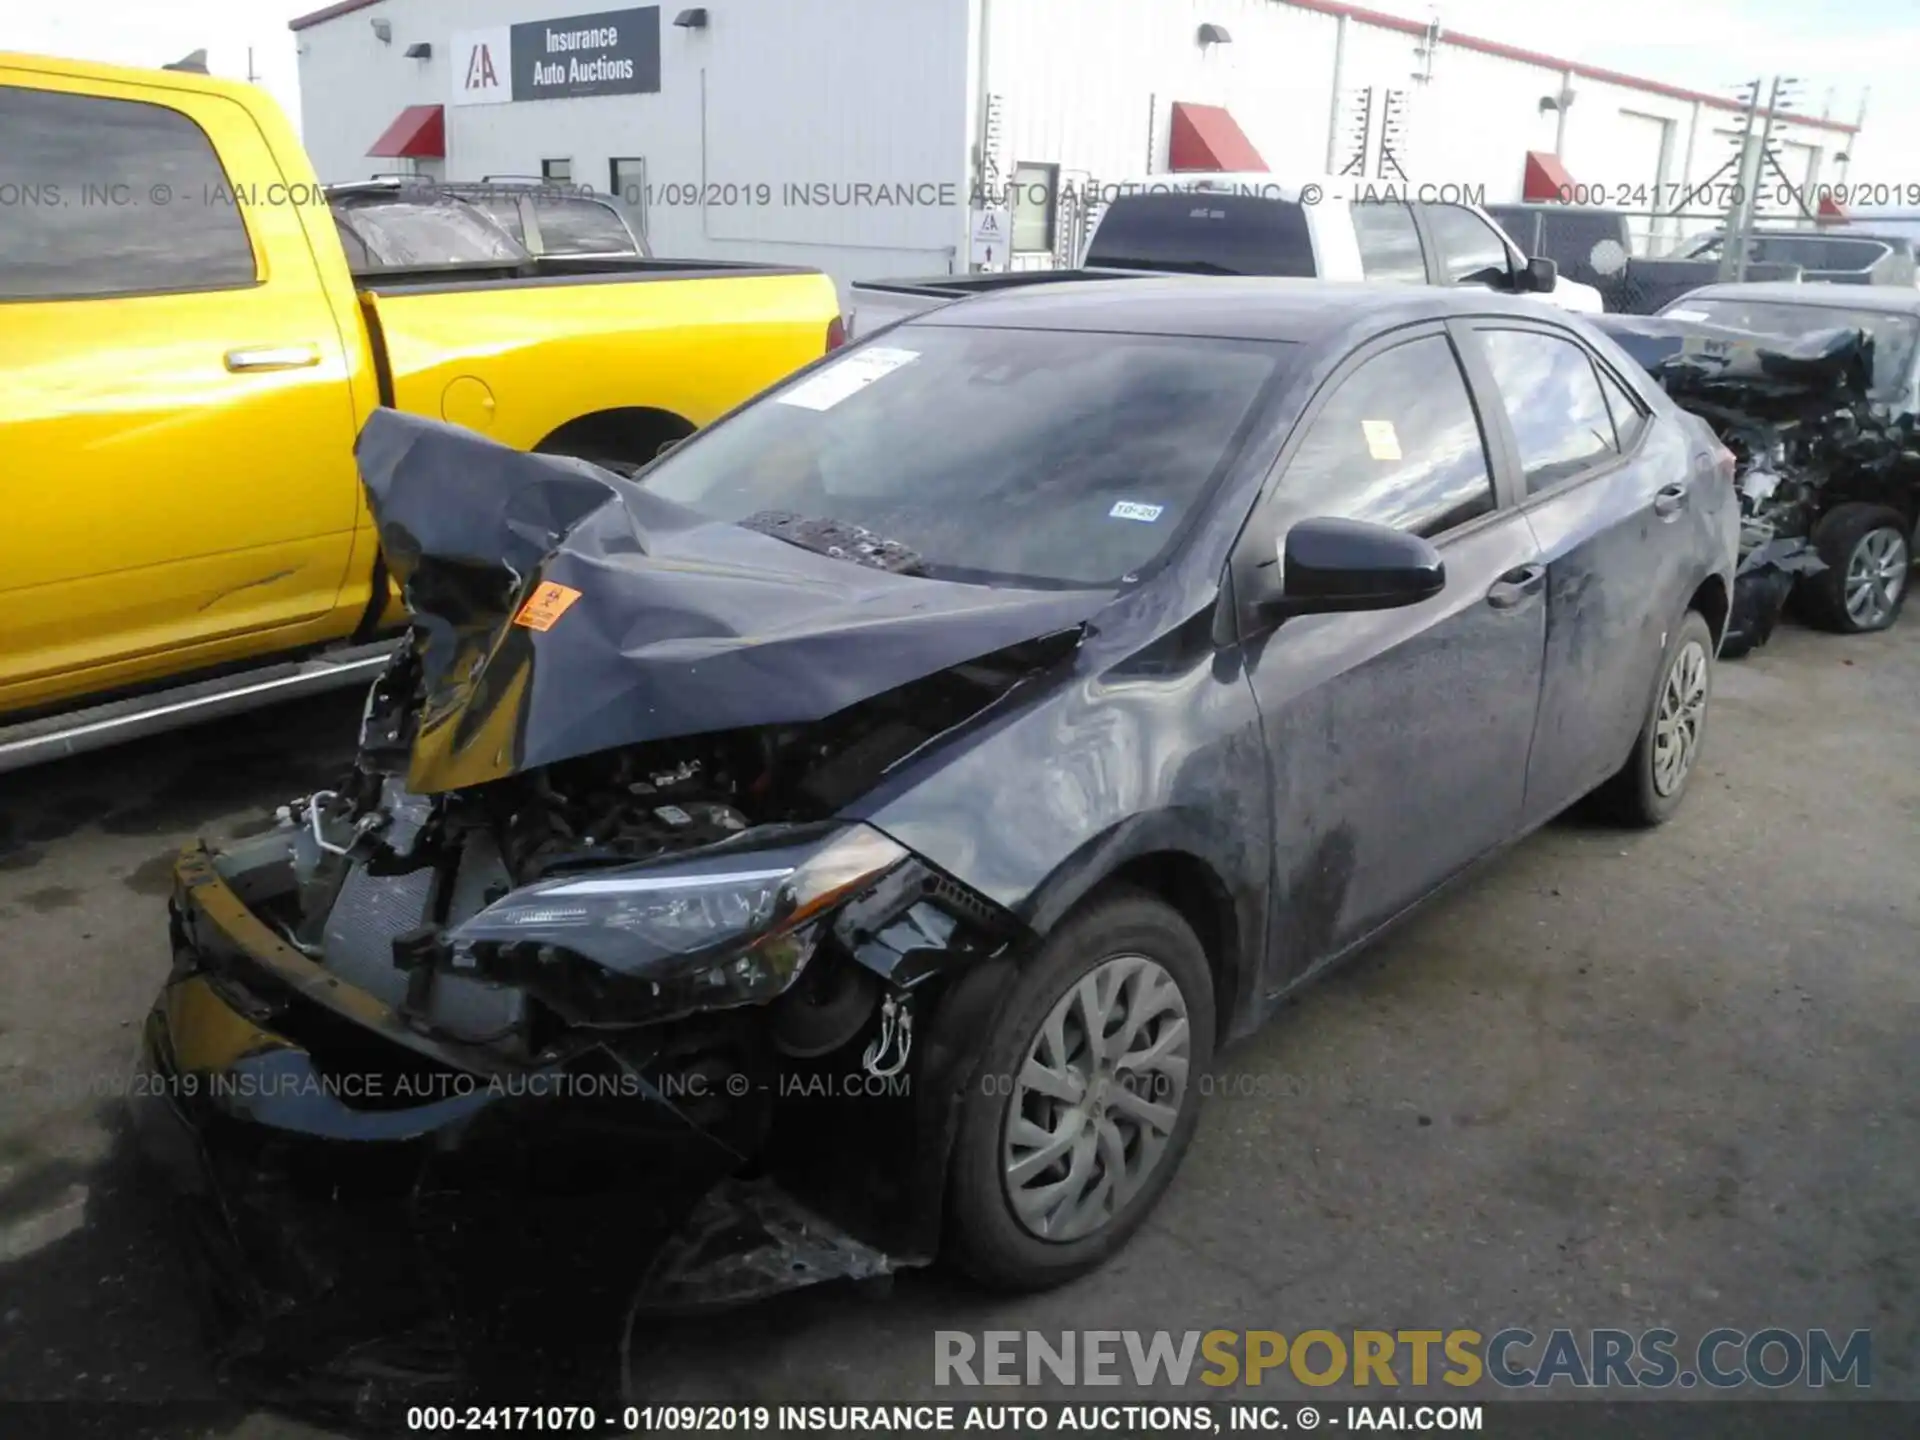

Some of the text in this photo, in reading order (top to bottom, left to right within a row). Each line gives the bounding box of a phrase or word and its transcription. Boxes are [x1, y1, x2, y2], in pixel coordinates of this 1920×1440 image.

[545, 27, 618, 53] Insurance
[533, 55, 634, 86] Auto Auctions
